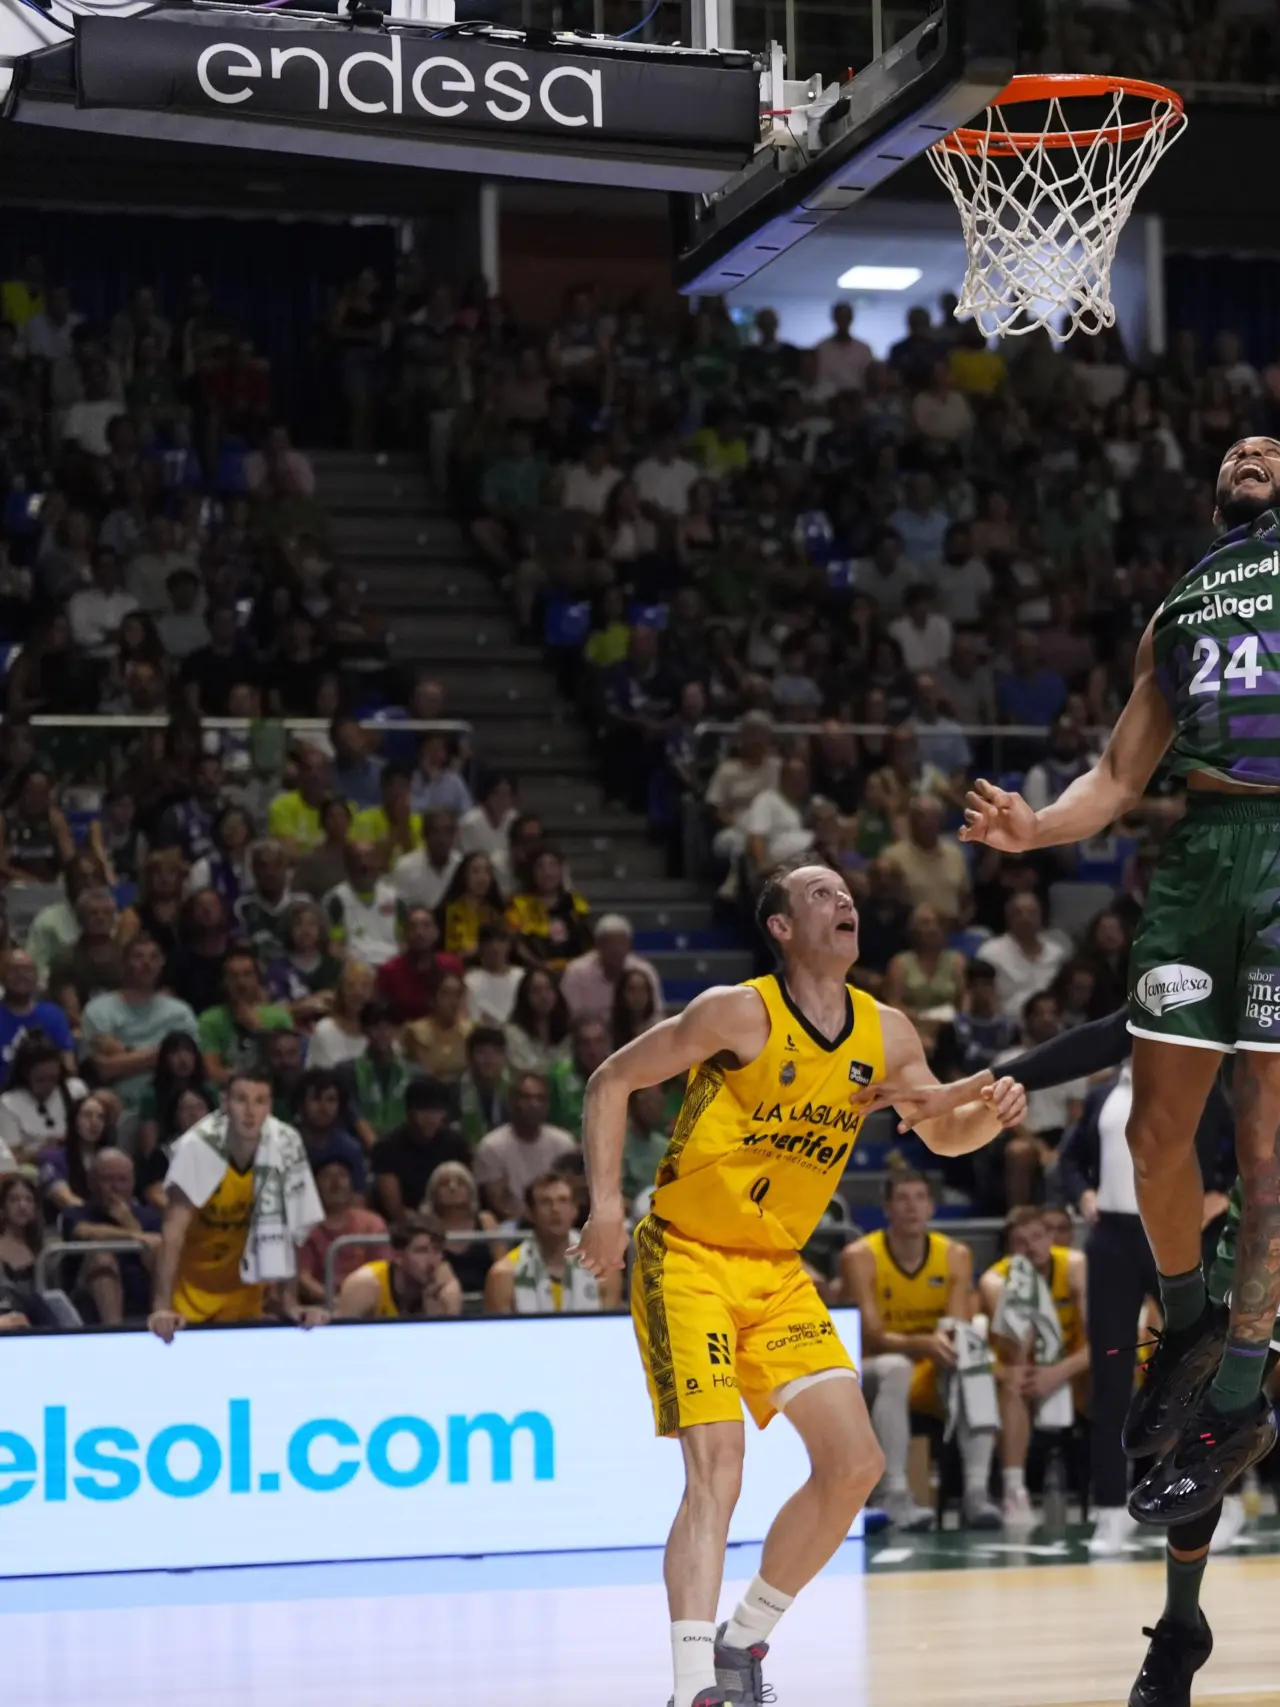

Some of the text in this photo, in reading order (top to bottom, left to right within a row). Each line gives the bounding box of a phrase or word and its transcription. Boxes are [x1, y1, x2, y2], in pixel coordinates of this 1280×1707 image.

[197, 35, 603, 127] endesa
[1188, 635, 1263, 695] 24
[1247, 968, 1275, 982] sabor
[752, 1101, 859, 1135] LA LAGUNA
[0, 1398, 555, 1502] elsol.com
